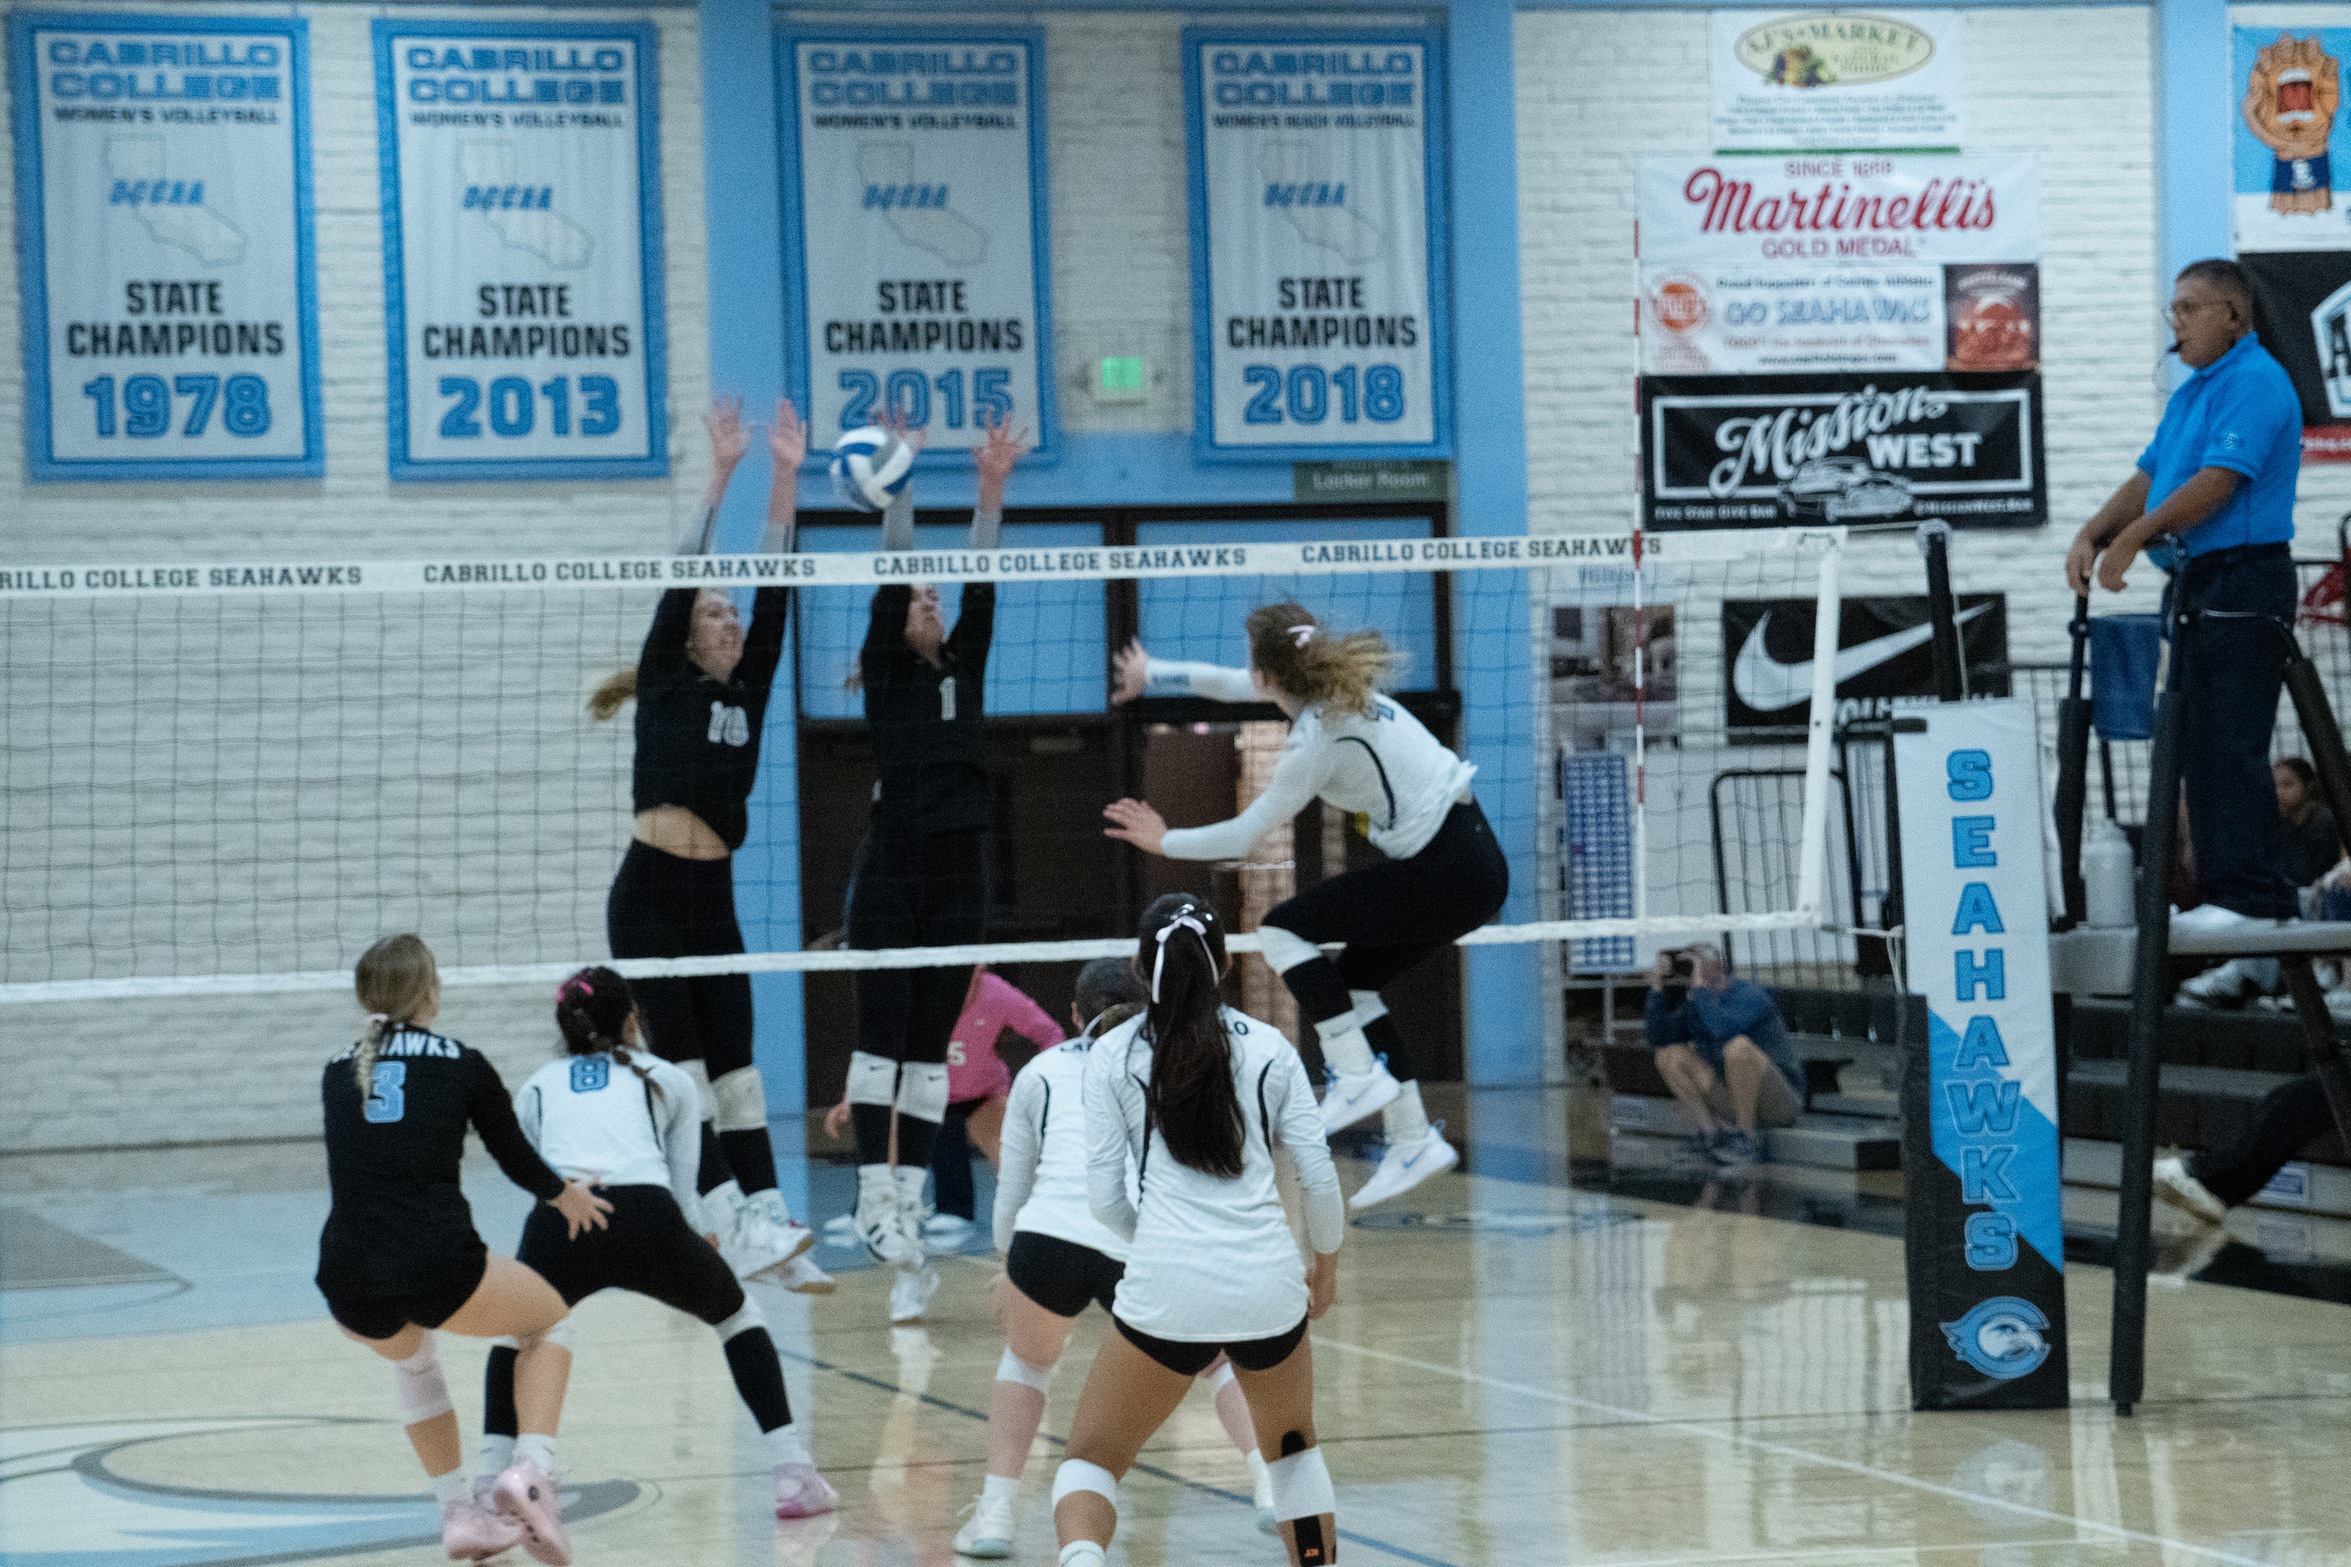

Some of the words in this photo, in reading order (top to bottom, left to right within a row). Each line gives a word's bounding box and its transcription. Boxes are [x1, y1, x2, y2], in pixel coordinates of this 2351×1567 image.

[1809, 22, 1920, 51] MARKET
[48, 41, 281, 69] CABRILLO
[407, 48, 625, 71] CABRILLO
[809, 51, 1019, 75] CABRILLO
[1213, 52, 1413, 75] CABRILLO
[50, 73, 281, 100] COLLEGE
[409, 78, 625, 104] COLLEGE
[811, 81, 1019, 106] COLLEGE
[1215, 82, 1414, 106] COLLEGE
[1785, 161, 1844, 179] SINCE
[1761, 236, 1829, 260] GOLD
[126, 281, 224, 316] STATE
[478, 284, 573, 318] STATE
[878, 280, 967, 315] STATE
[1278, 277, 1365, 310] STATE
[1726, 301, 1768, 325] GO
[66, 322, 285, 358] CHAMPIONS
[423, 325, 630, 359] CHAMPIONS
[825, 319, 1024, 355] CHAMPIONS
[1227, 316, 1417, 349] CHAMPIONS
[83, 373, 273, 440] 1978
[437, 374, 623, 439] 2013
[836, 367, 1014, 432] 2015
[1243, 365, 1405, 426] 2018
[1866, 432, 1981, 469] WEST
[873, 554, 991, 577] CABRILLO
[999, 551, 1101, 574] COLLEGE
[1108, 546, 1247, 571] SEAHAWKS
[1301, 543, 1415, 564] CABRILLO
[1421, 540, 1522, 562] COLLEGE
[85, 568, 200, 590] COLLEGE
[208, 565, 363, 588] SEAHAWKS
[423, 562, 548, 584] CABRILLO
[555, 560, 663, 581] COLLEGE
[671, 557, 817, 579] SEAHAWKS
[939, 676, 957, 721] 1
[1944, 748, 2022, 1271] SEAHAWKS
[569, 1053, 611, 1094] 8
[363, 1060, 407, 1124] 3
